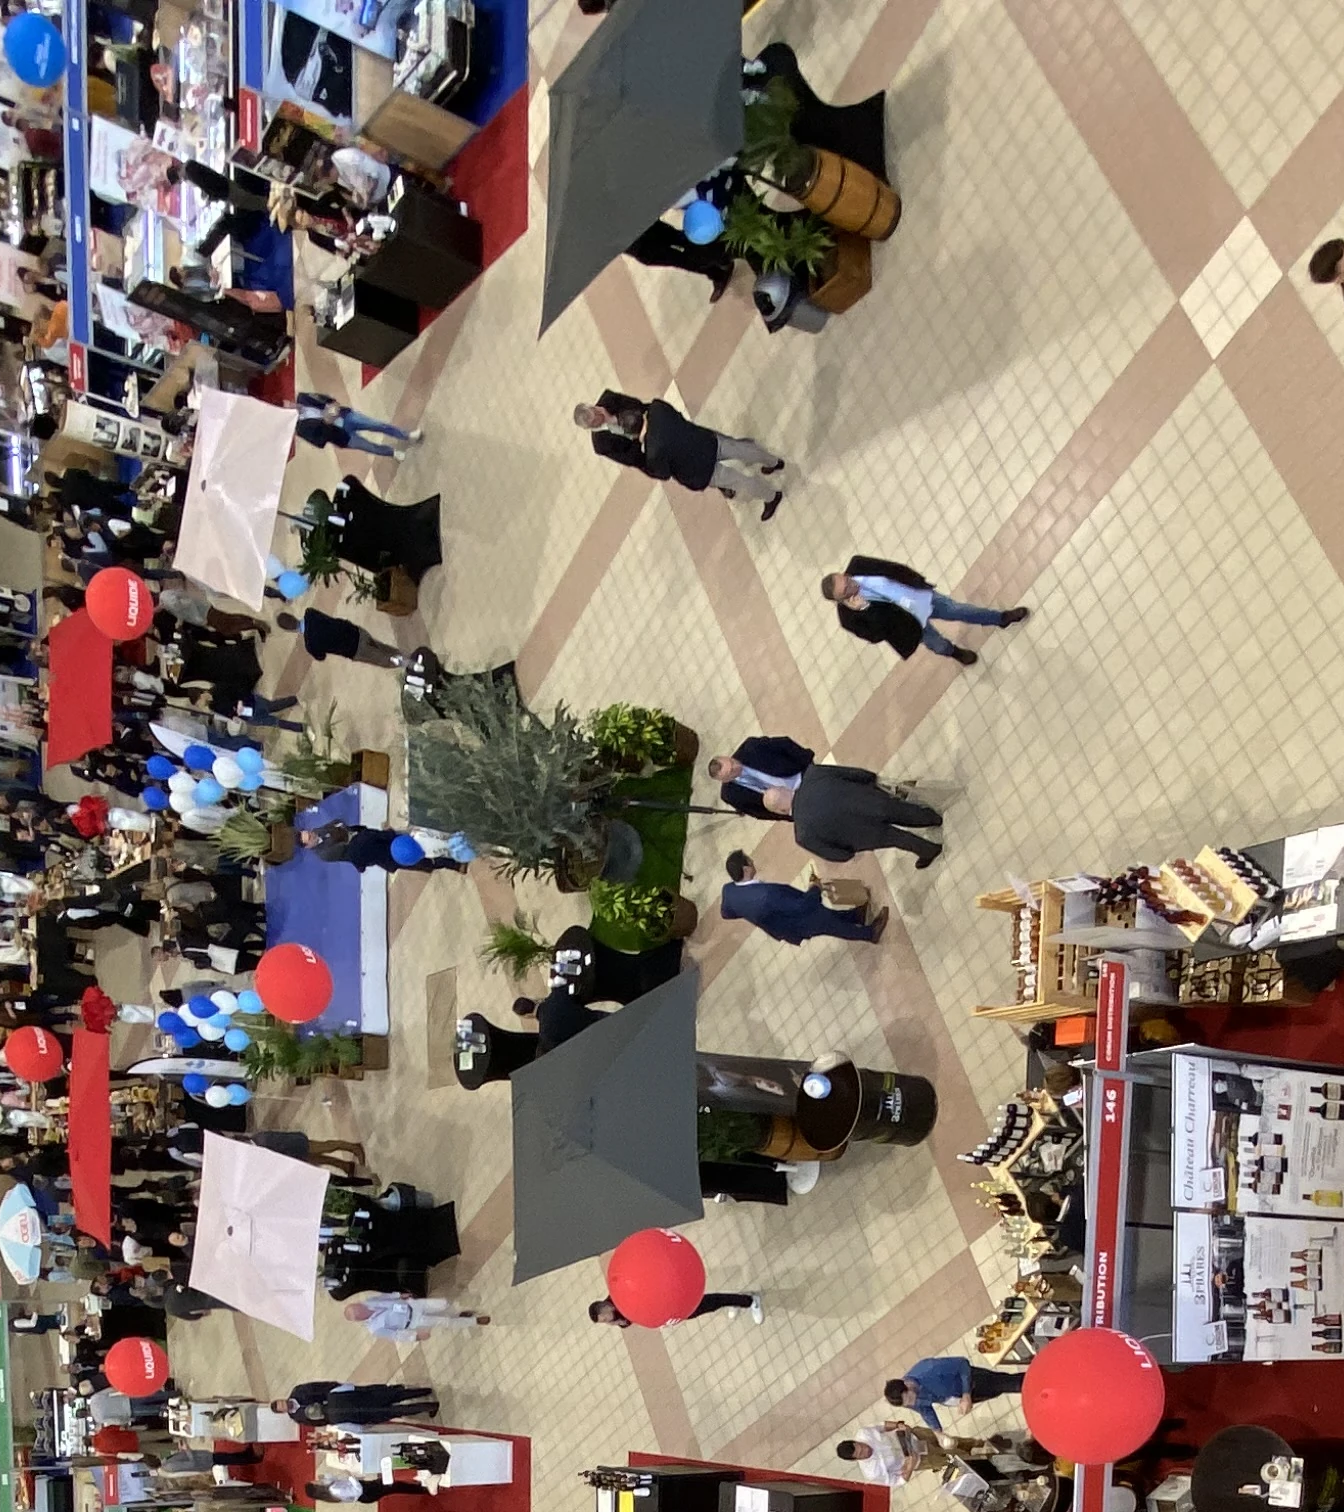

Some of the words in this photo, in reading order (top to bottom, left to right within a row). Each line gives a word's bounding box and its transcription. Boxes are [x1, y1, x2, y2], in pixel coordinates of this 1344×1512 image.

[125, 578, 139, 628] LIQUIDE
[1104, 1088, 1118, 1123] 146
[1184, 1061, 1197, 1134] Charreau
[1183, 1138, 1196, 1202] Château
